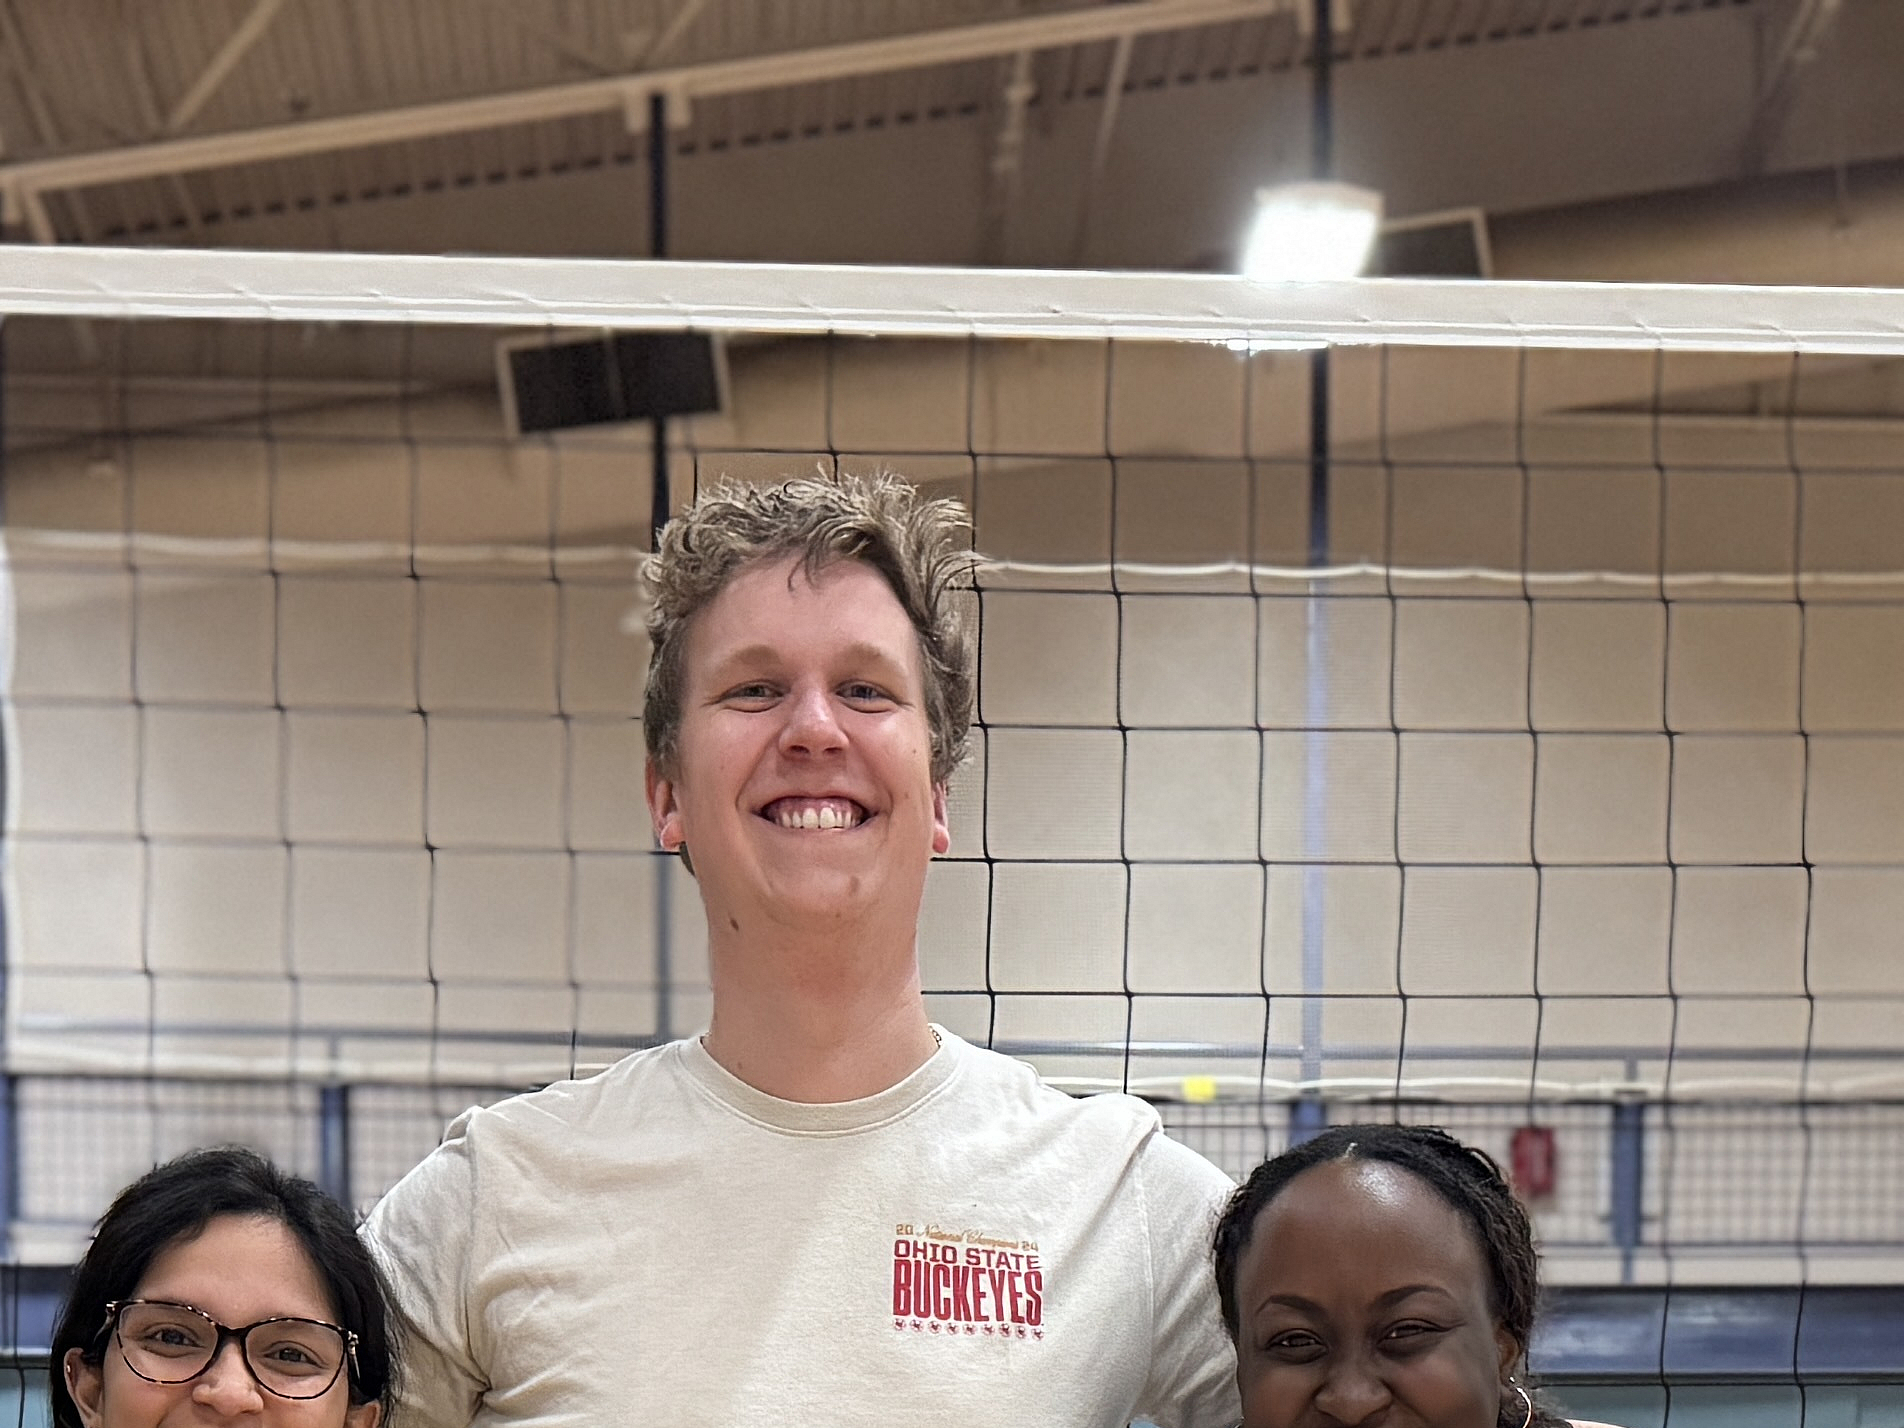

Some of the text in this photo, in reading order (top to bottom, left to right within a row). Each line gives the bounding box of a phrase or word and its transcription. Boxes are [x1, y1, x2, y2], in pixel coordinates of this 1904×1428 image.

[894, 1239, 1043, 1270] OHIO STATE
[893, 1259, 1043, 1326] BUCKEYES
